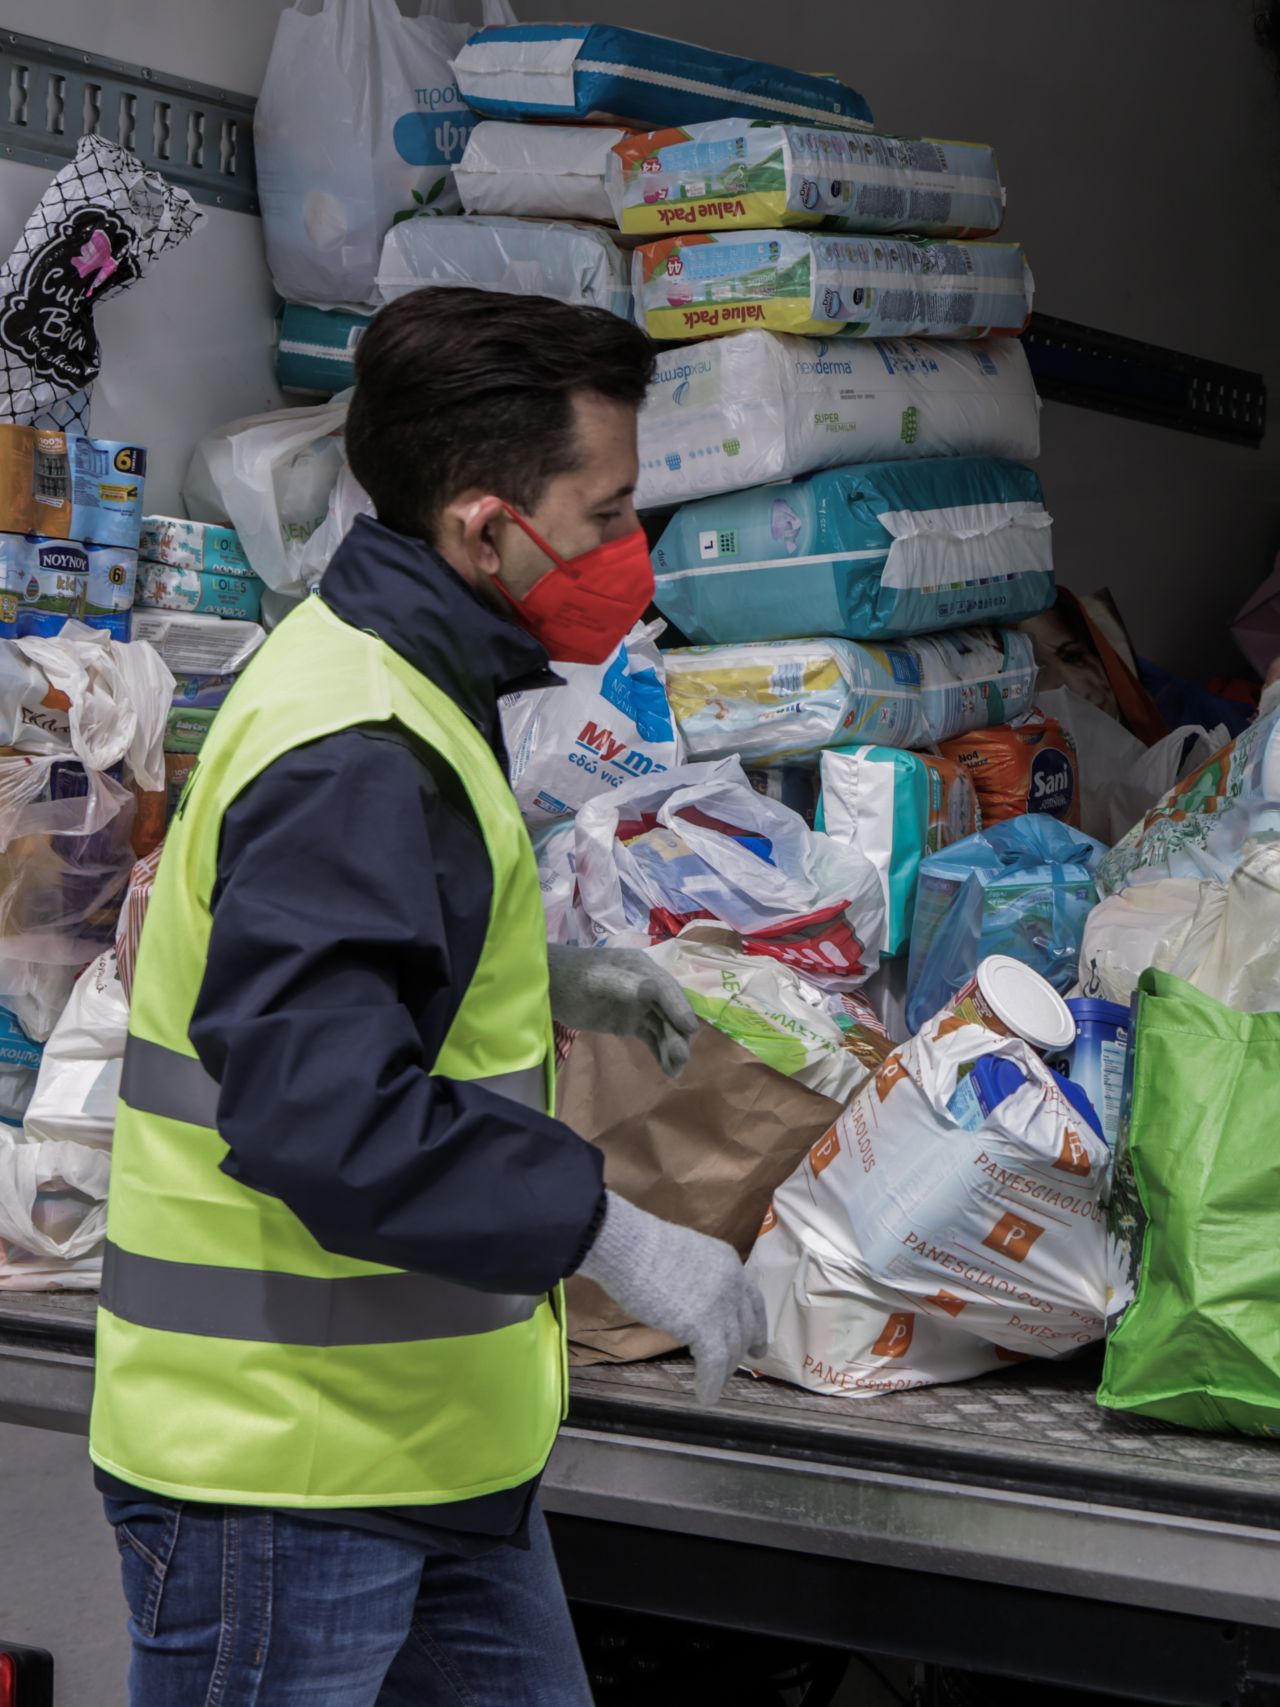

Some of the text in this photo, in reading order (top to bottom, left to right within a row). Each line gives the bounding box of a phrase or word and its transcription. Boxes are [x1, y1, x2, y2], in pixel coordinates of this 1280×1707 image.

[656, 200, 746, 225] Value Pack
[667, 261, 682, 276] 44
[682, 305, 766, 328] Value Pack
[795, 356, 853, 375] nexderma
[815, 413, 840, 424] SUPER
[826, 424, 857, 433] PREMIUM
[112, 566, 123, 583] 6
[576, 720, 626, 761] My
[568, 752, 598, 774] εδώ
[1033, 763, 1069, 798] Sani
[1002, 1224, 1026, 1247] P
[888, 1322, 907, 1347] P
